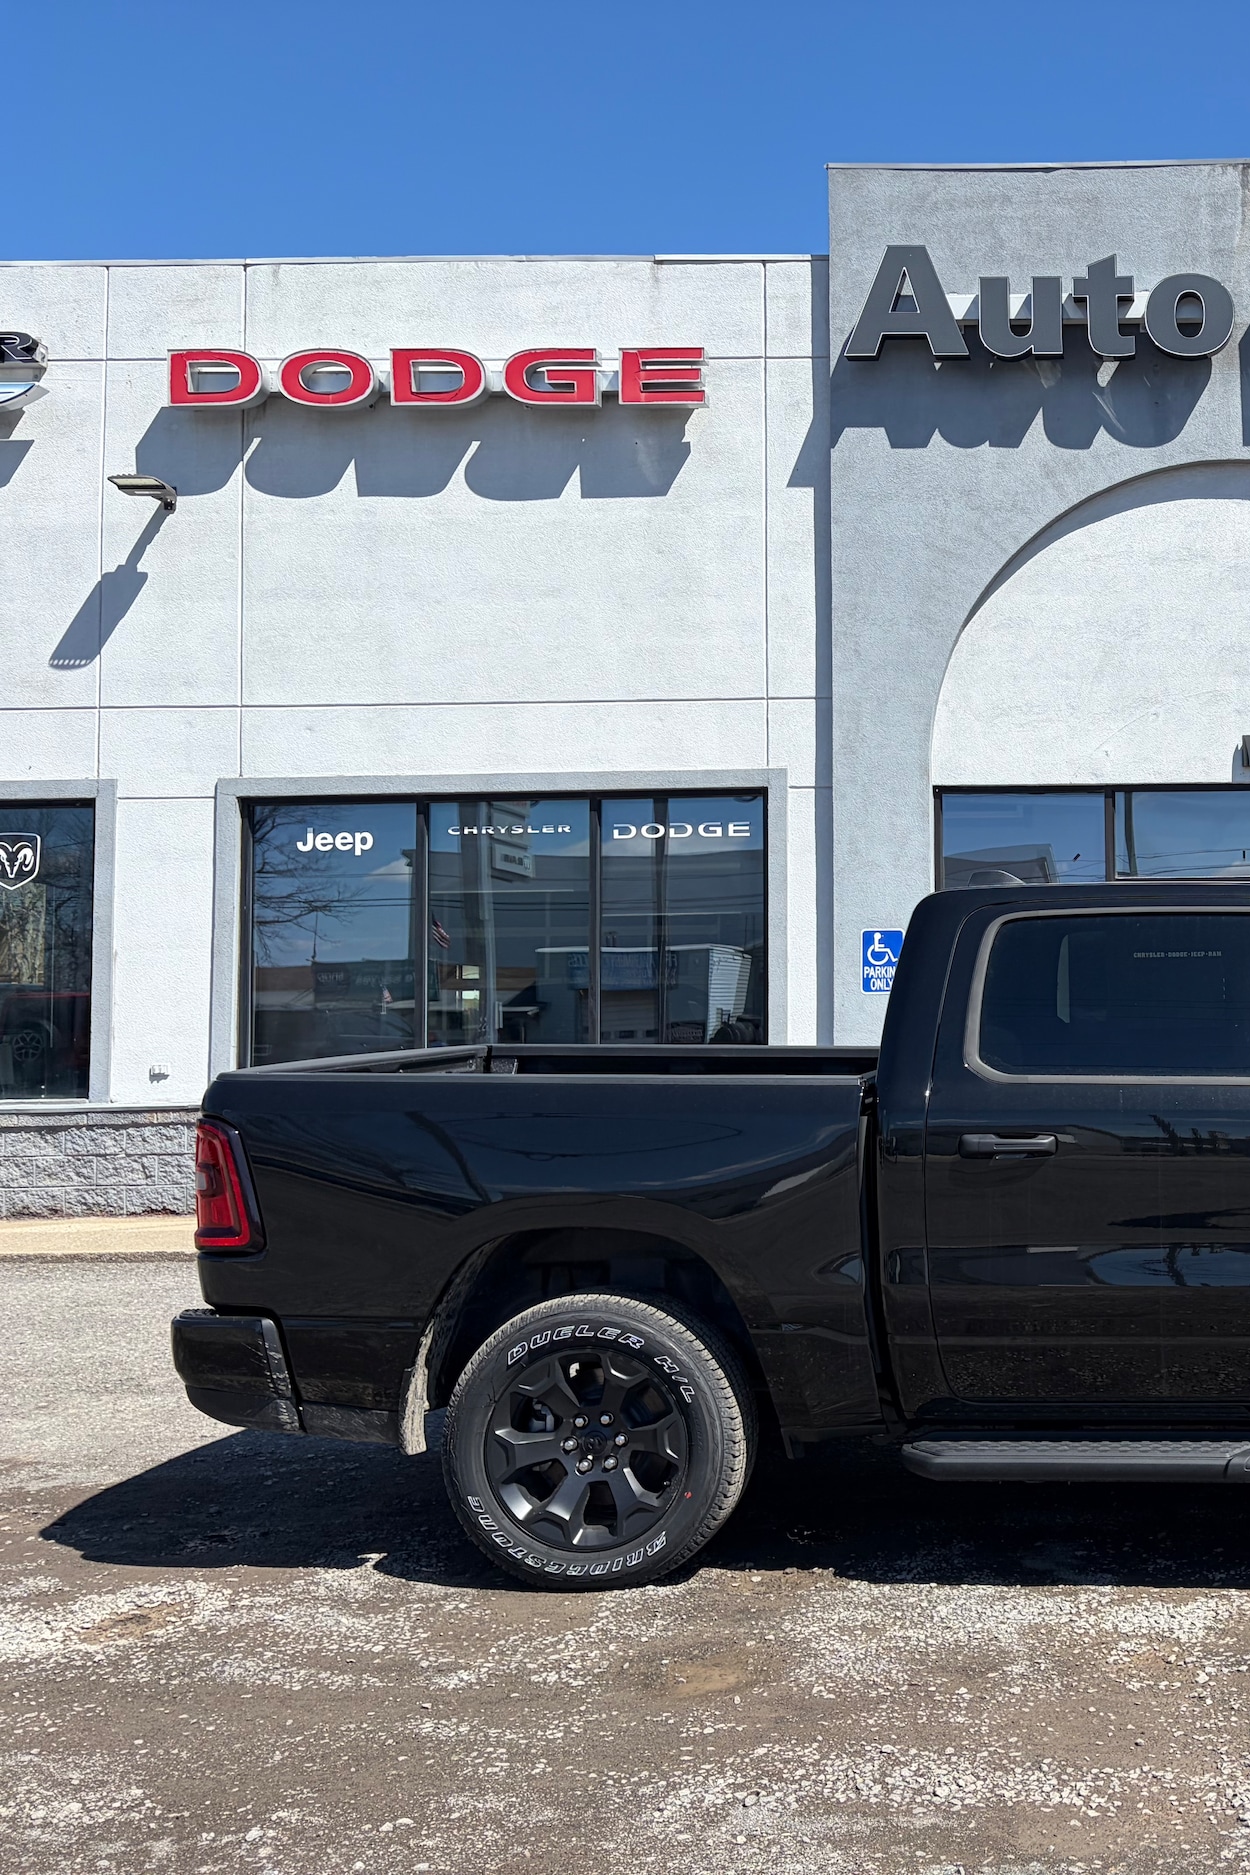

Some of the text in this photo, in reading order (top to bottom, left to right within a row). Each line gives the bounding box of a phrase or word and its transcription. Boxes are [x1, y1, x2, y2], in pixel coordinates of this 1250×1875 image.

[844, 244, 1234, 360] Auto
[167, 347, 708, 408] DODGE
[296, 827, 374, 856] Jeep
[447, 824, 571, 835] CHRYSLER
[613, 821, 751, 839] DODGE
[863, 966, 896, 979] PARKIN
[507, 1324, 645, 1366] DUELER
[467, 1494, 667, 1577] BRIDGESTONE
